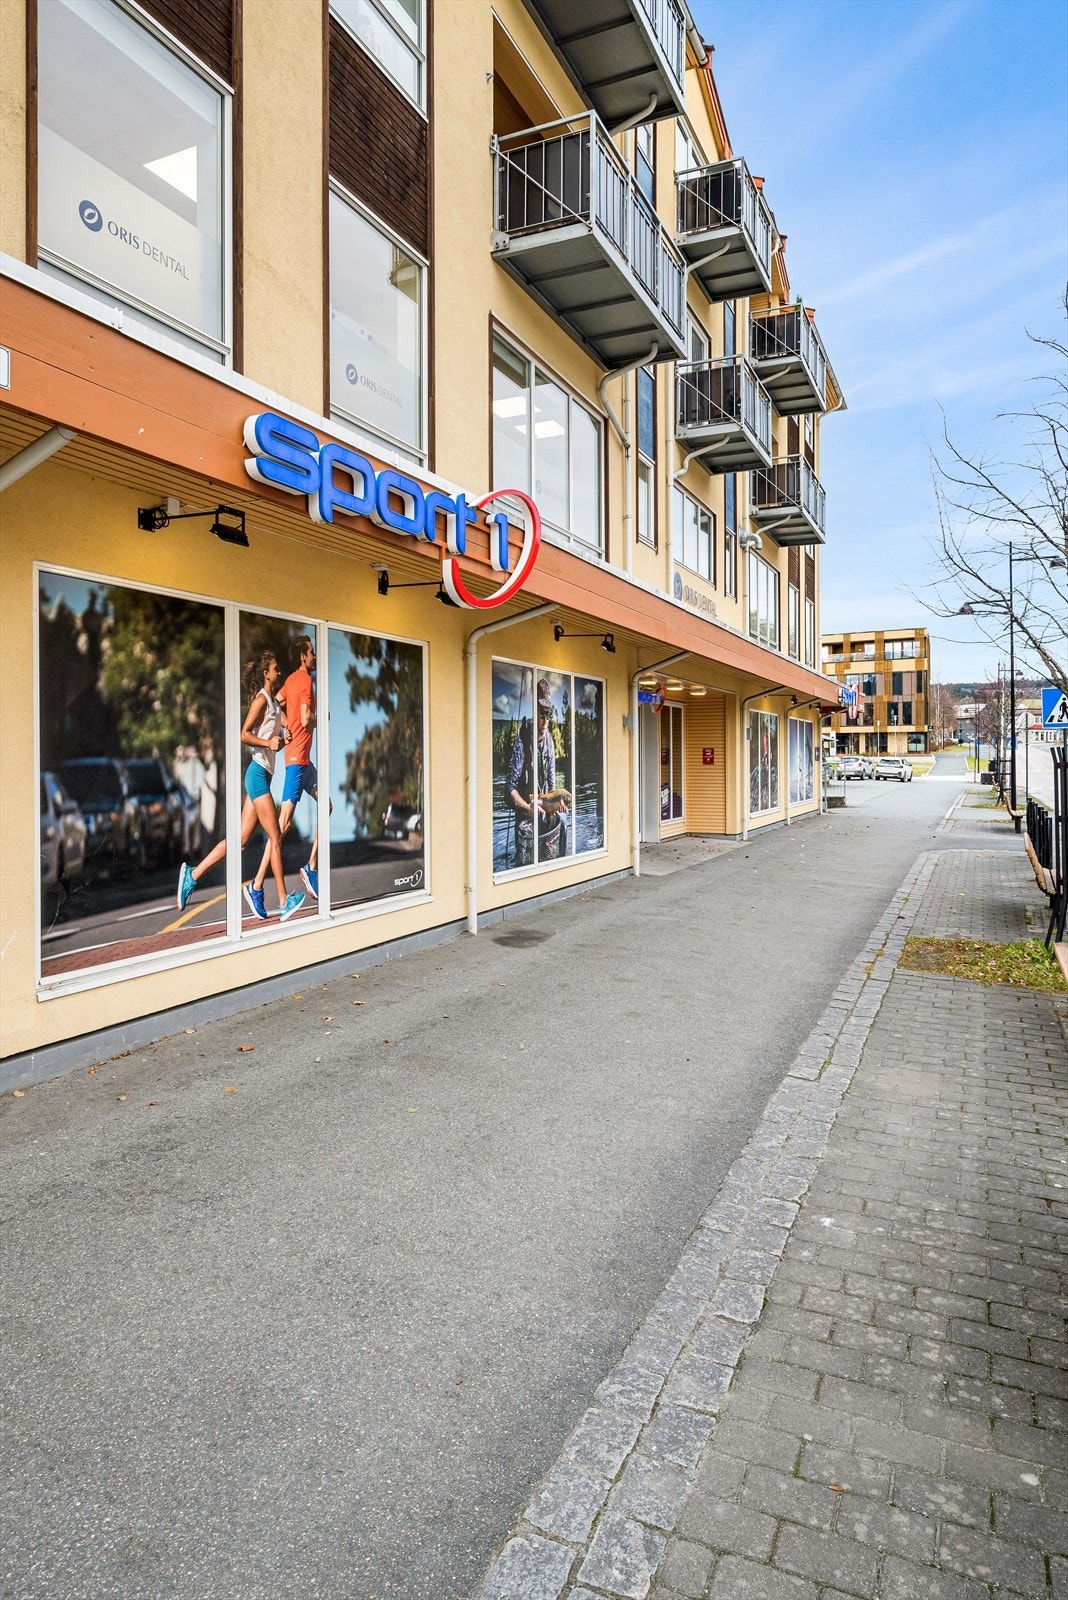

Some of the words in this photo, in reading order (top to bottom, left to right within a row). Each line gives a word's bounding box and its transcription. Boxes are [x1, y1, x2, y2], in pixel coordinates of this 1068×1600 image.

[107, 220, 140, 250] ORIS
[142, 241, 190, 281] DENTAL
[360, 375, 378, 393] ORIS
[377, 385, 404, 409] DENTAL
[486, 512, 509, 571] 1
[394, 875, 414, 886] sport
